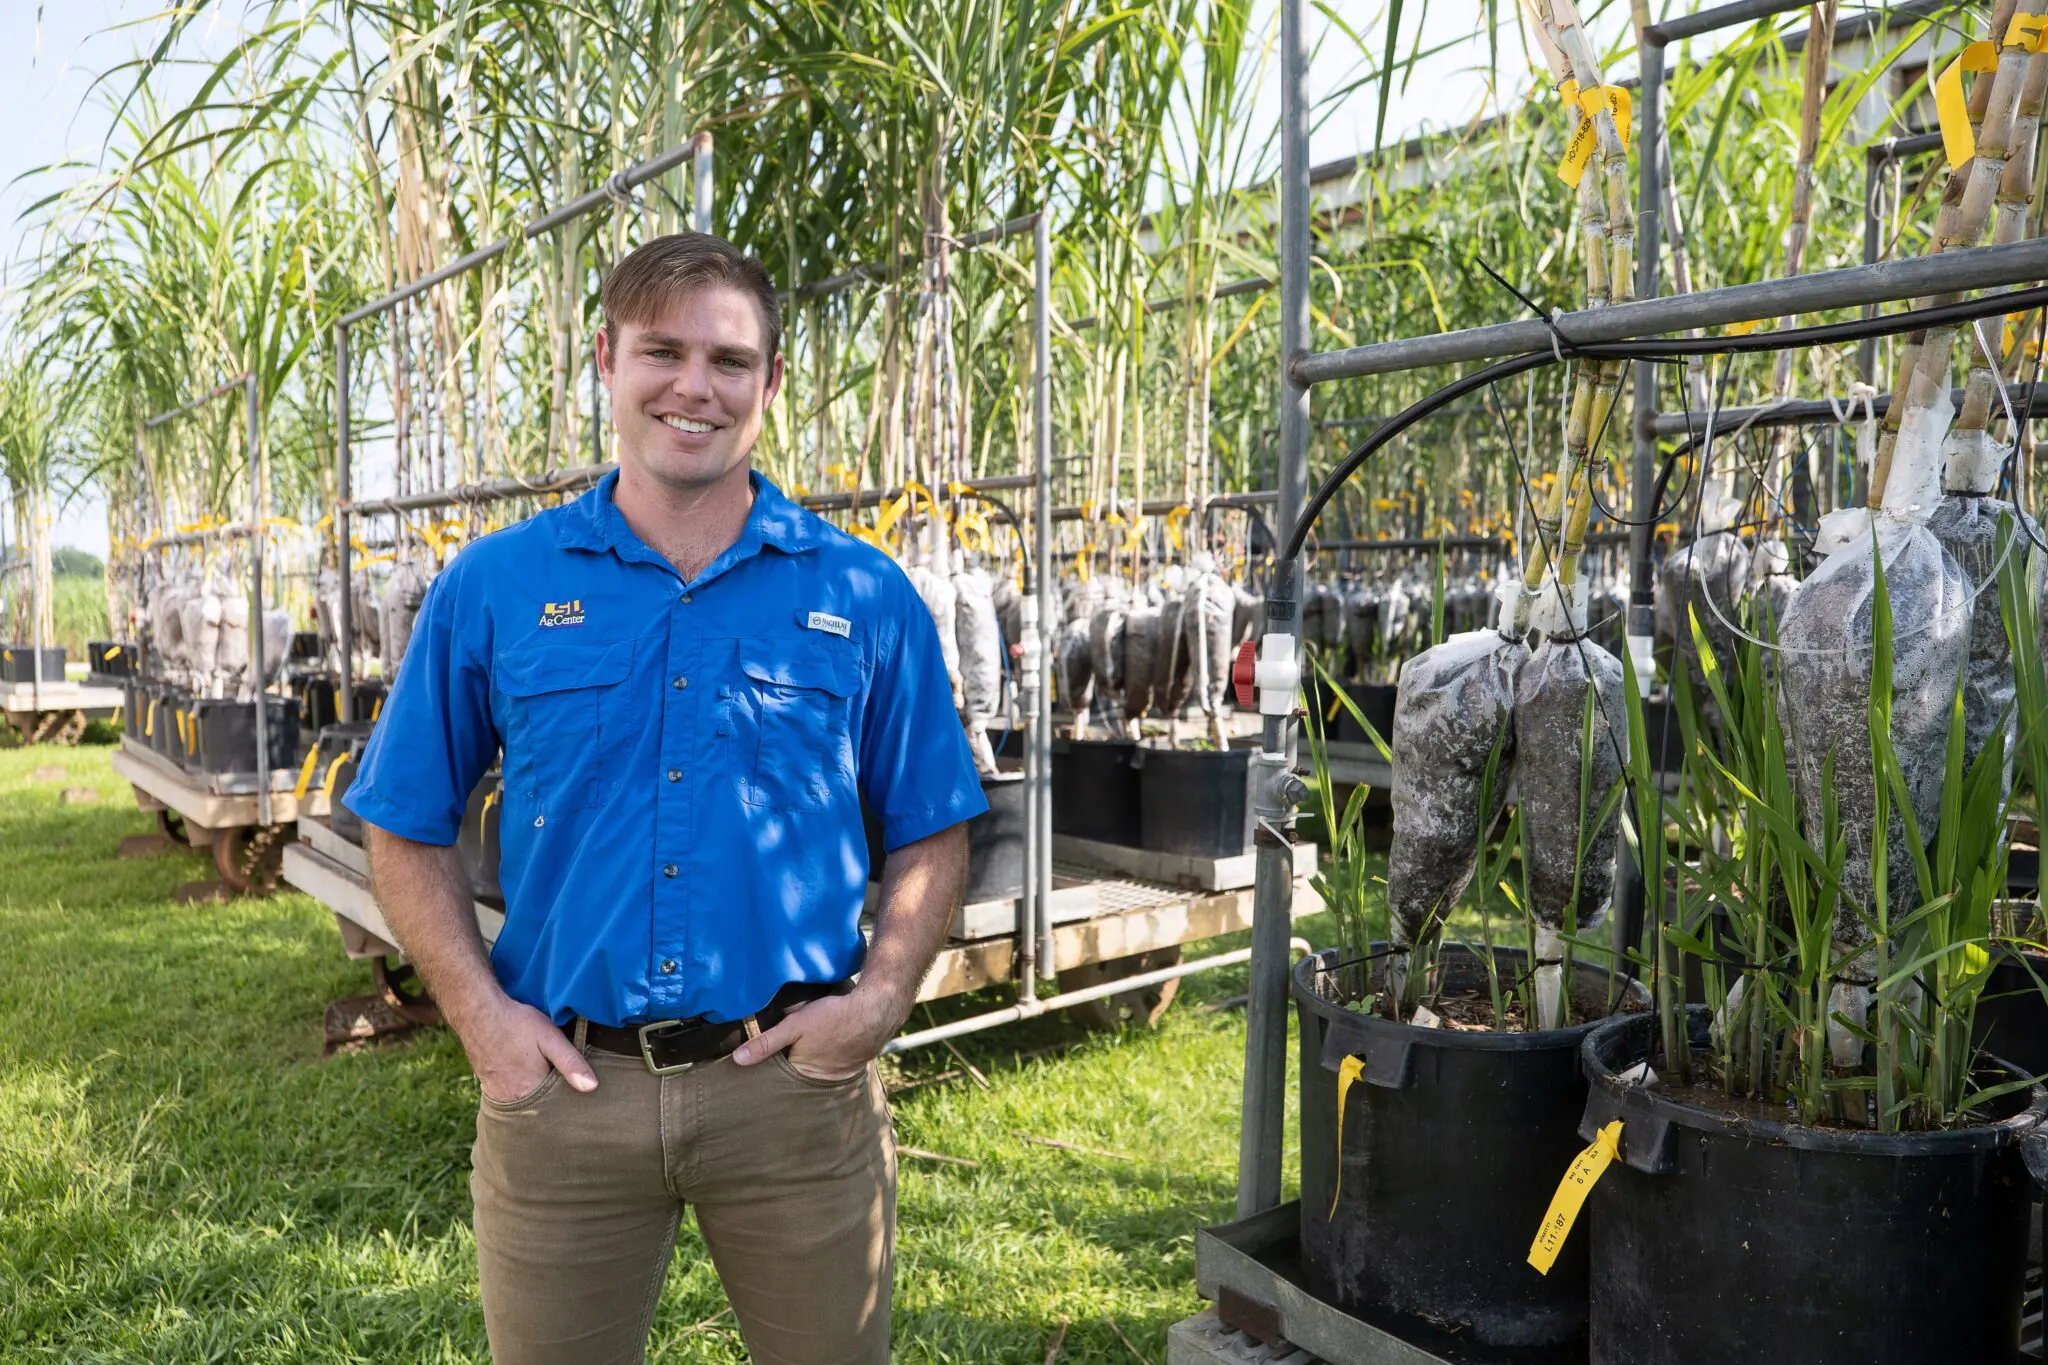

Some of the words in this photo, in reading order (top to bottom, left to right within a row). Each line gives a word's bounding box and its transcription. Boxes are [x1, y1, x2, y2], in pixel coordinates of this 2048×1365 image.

[544, 599, 585, 616] LSU
[1576, 1177, 1584, 1185] 6
[1583, 1167, 1591, 1176] A
